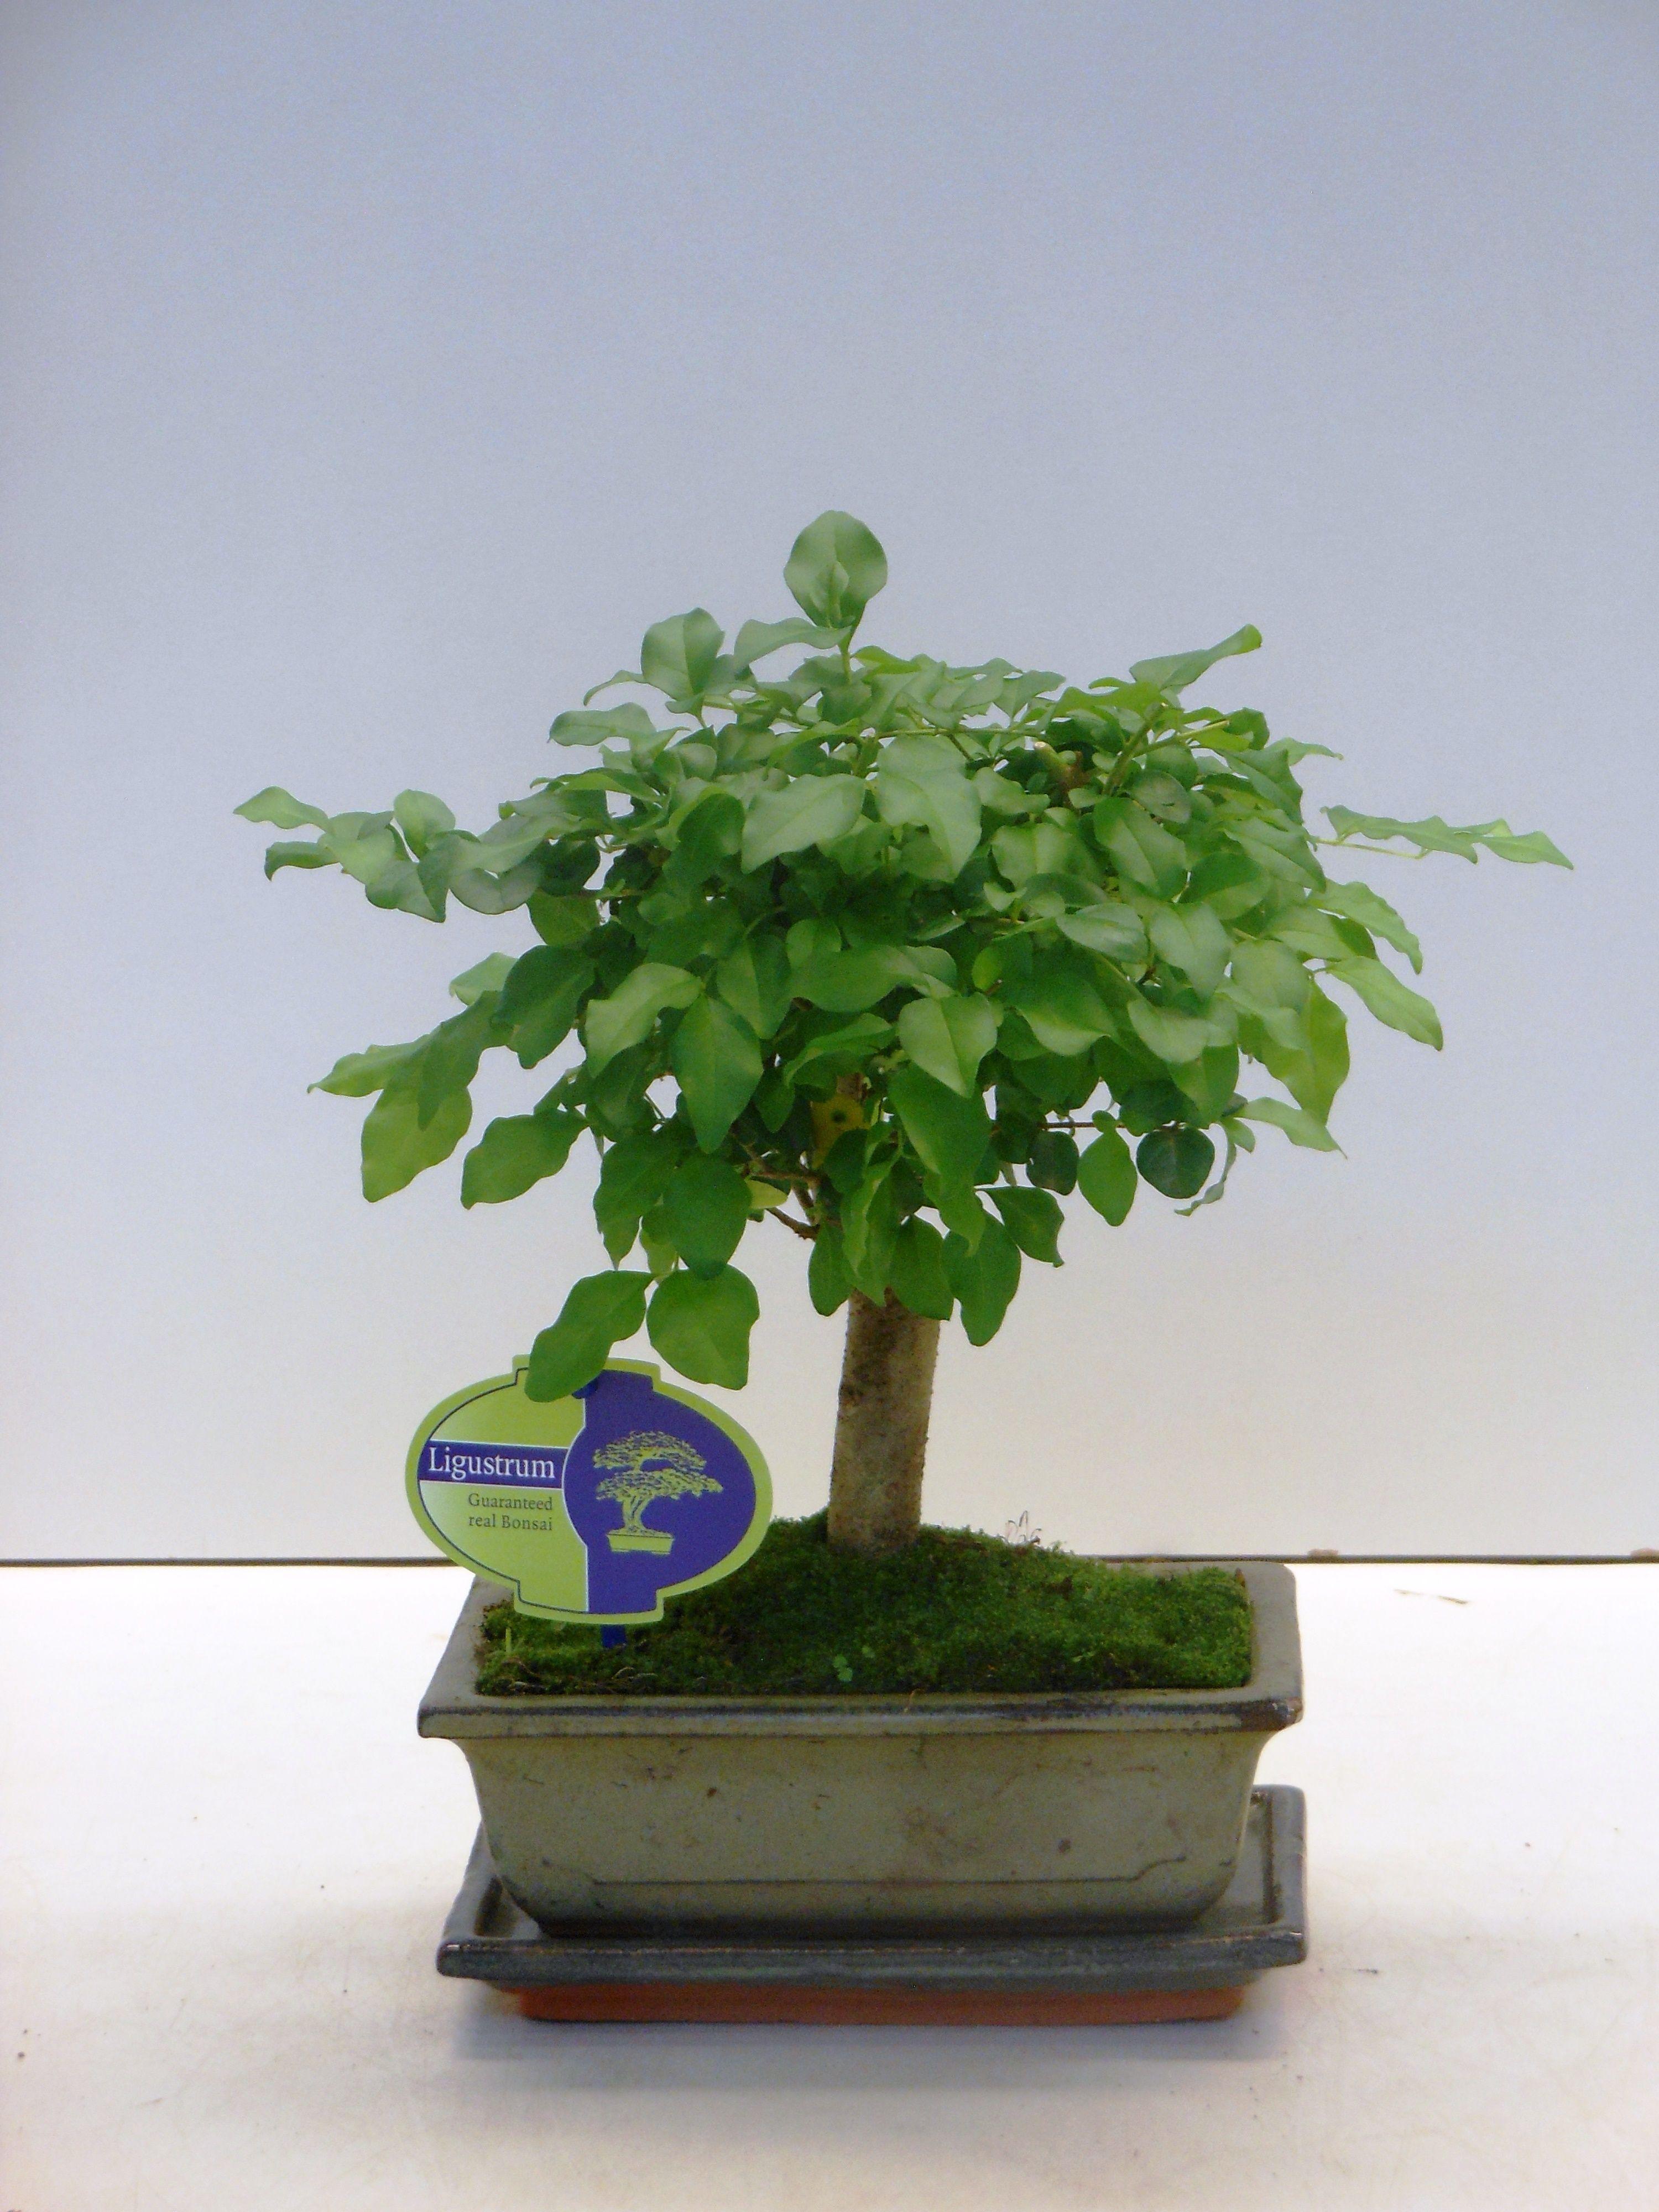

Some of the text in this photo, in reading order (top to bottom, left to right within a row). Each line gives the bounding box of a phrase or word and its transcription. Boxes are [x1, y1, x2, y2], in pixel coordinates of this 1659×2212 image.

[429, 1446, 555, 1480] Ligustrum
[468, 1492, 553, 1511] Guaranteed
[468, 1514, 553, 1531] real Bonsai
